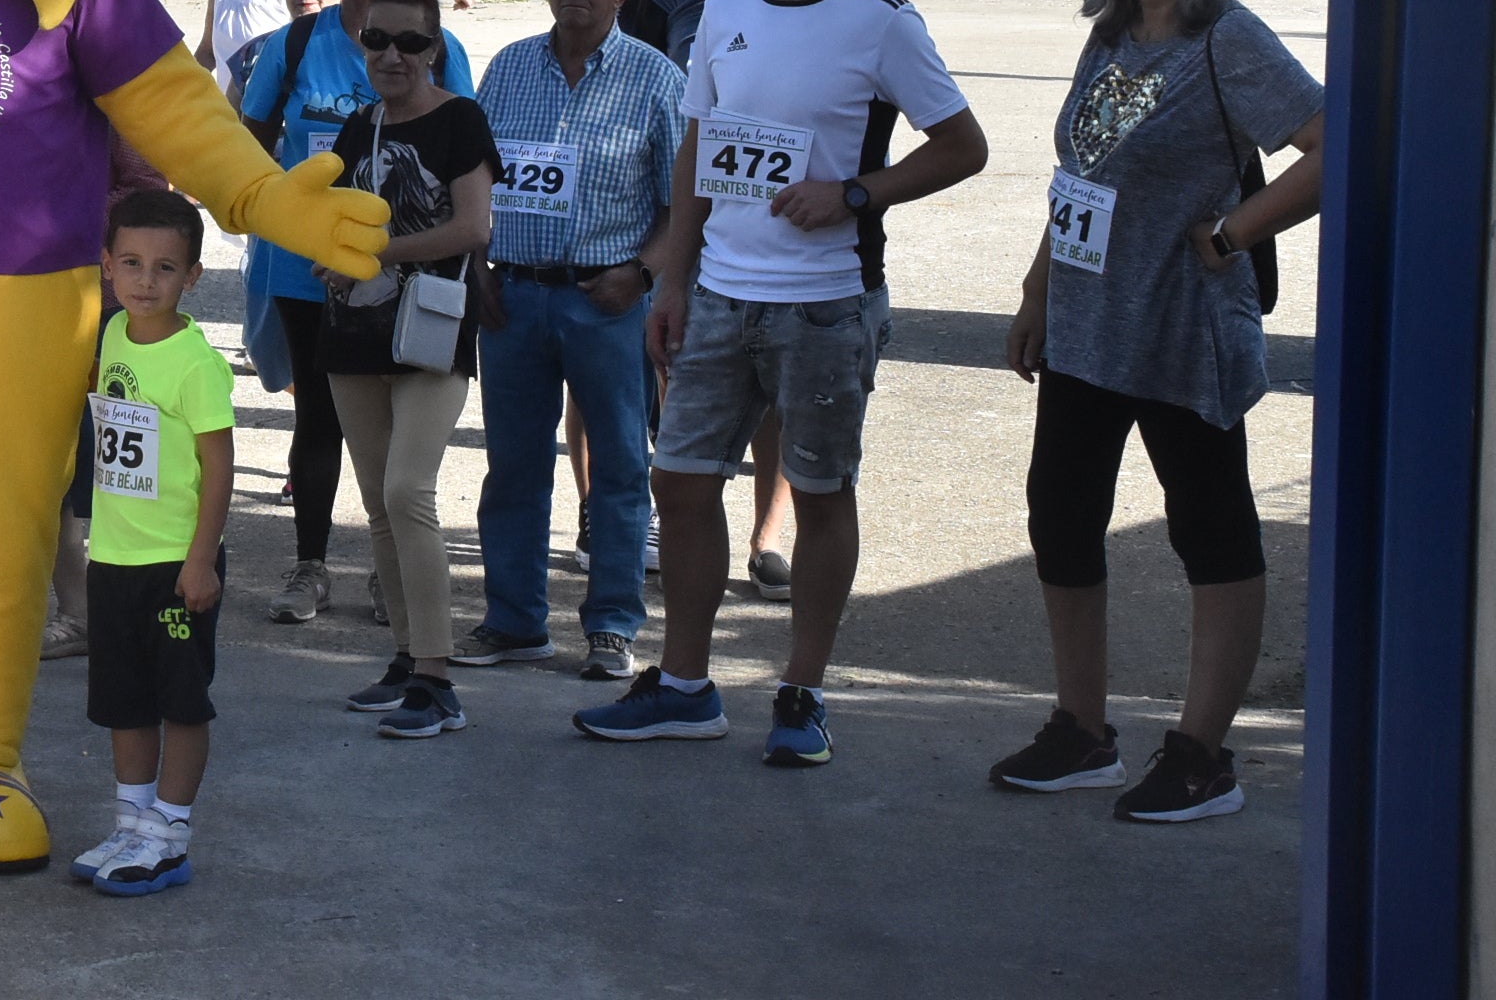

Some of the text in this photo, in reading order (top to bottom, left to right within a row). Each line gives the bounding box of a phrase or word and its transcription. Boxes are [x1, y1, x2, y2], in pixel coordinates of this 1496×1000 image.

[708, 126, 751, 140] marcha
[498, 145, 530, 158] marcha
[712, 144, 792, 184] 472
[498, 162, 564, 194] 429
[700, 178, 749, 197] FUENTES
[751, 183, 763, 199] DE
[491, 193, 569, 212] FUENTES DE BÉJAR
[1055, 239, 1068, 256] DE
[1068, 242, 1102, 267] BÉJAR
[104, 470, 115, 487] DE
[117, 470, 153, 493] BÉJAR
[168, 622, 191, 640] GO
